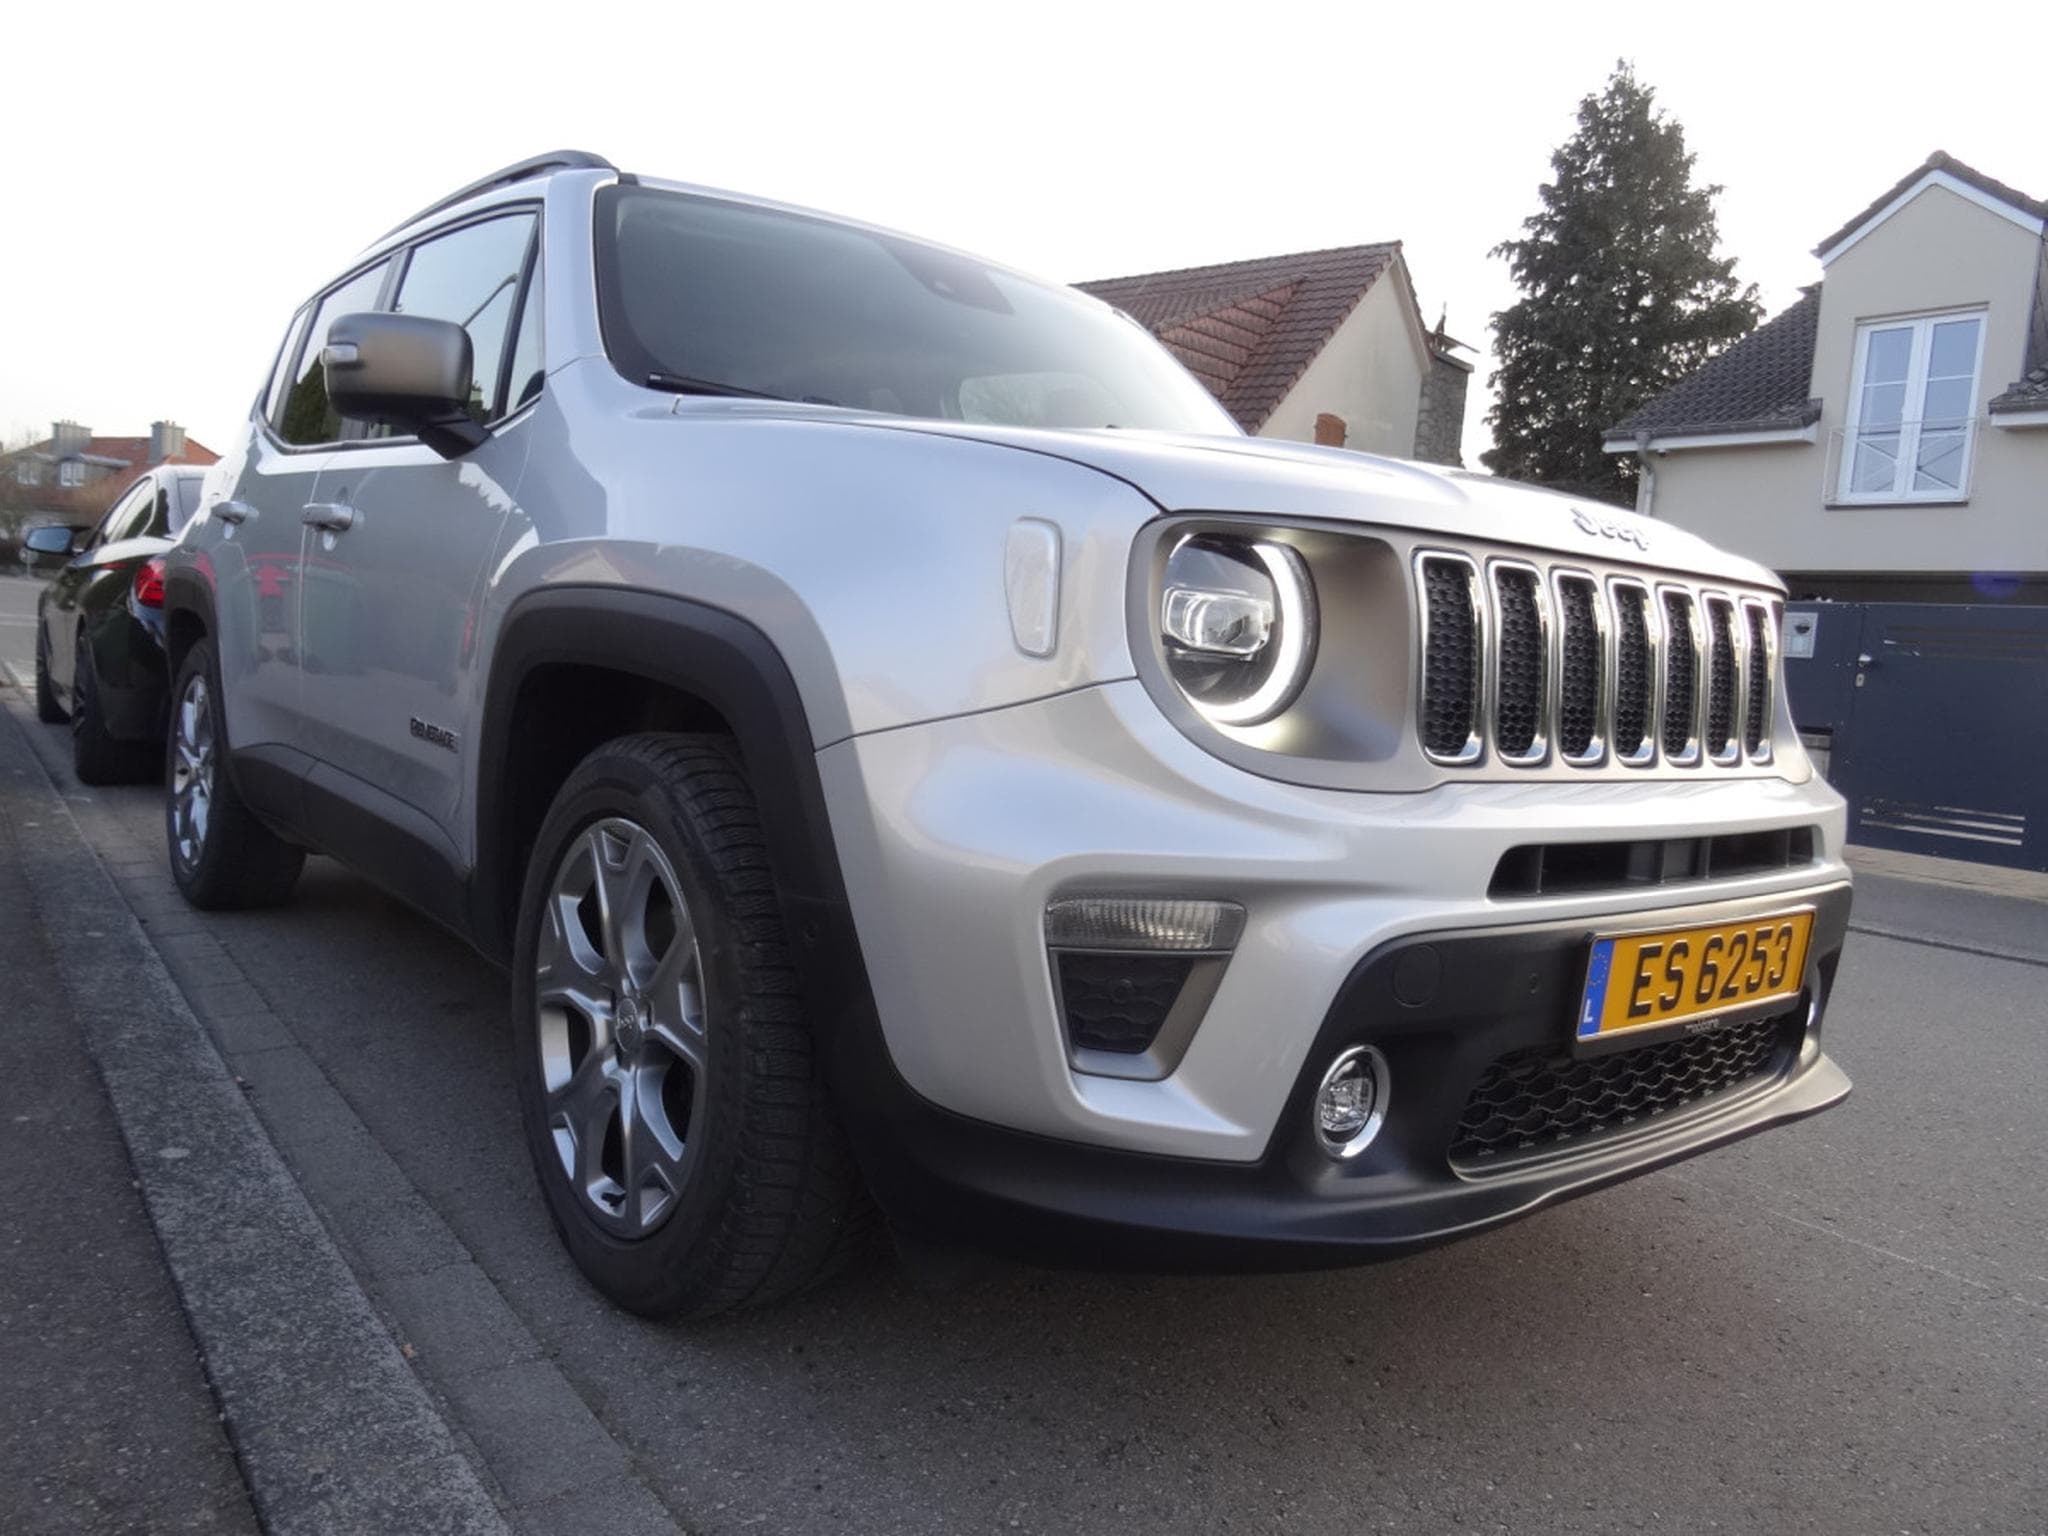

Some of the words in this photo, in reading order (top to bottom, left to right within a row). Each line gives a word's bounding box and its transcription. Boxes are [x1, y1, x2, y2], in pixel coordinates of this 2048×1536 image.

[1569, 507, 1650, 552] Jeep
[1627, 940, 1690, 1018] ES
[1695, 923, 1793, 1004] 6253
[1583, 999, 1594, 1024] L
